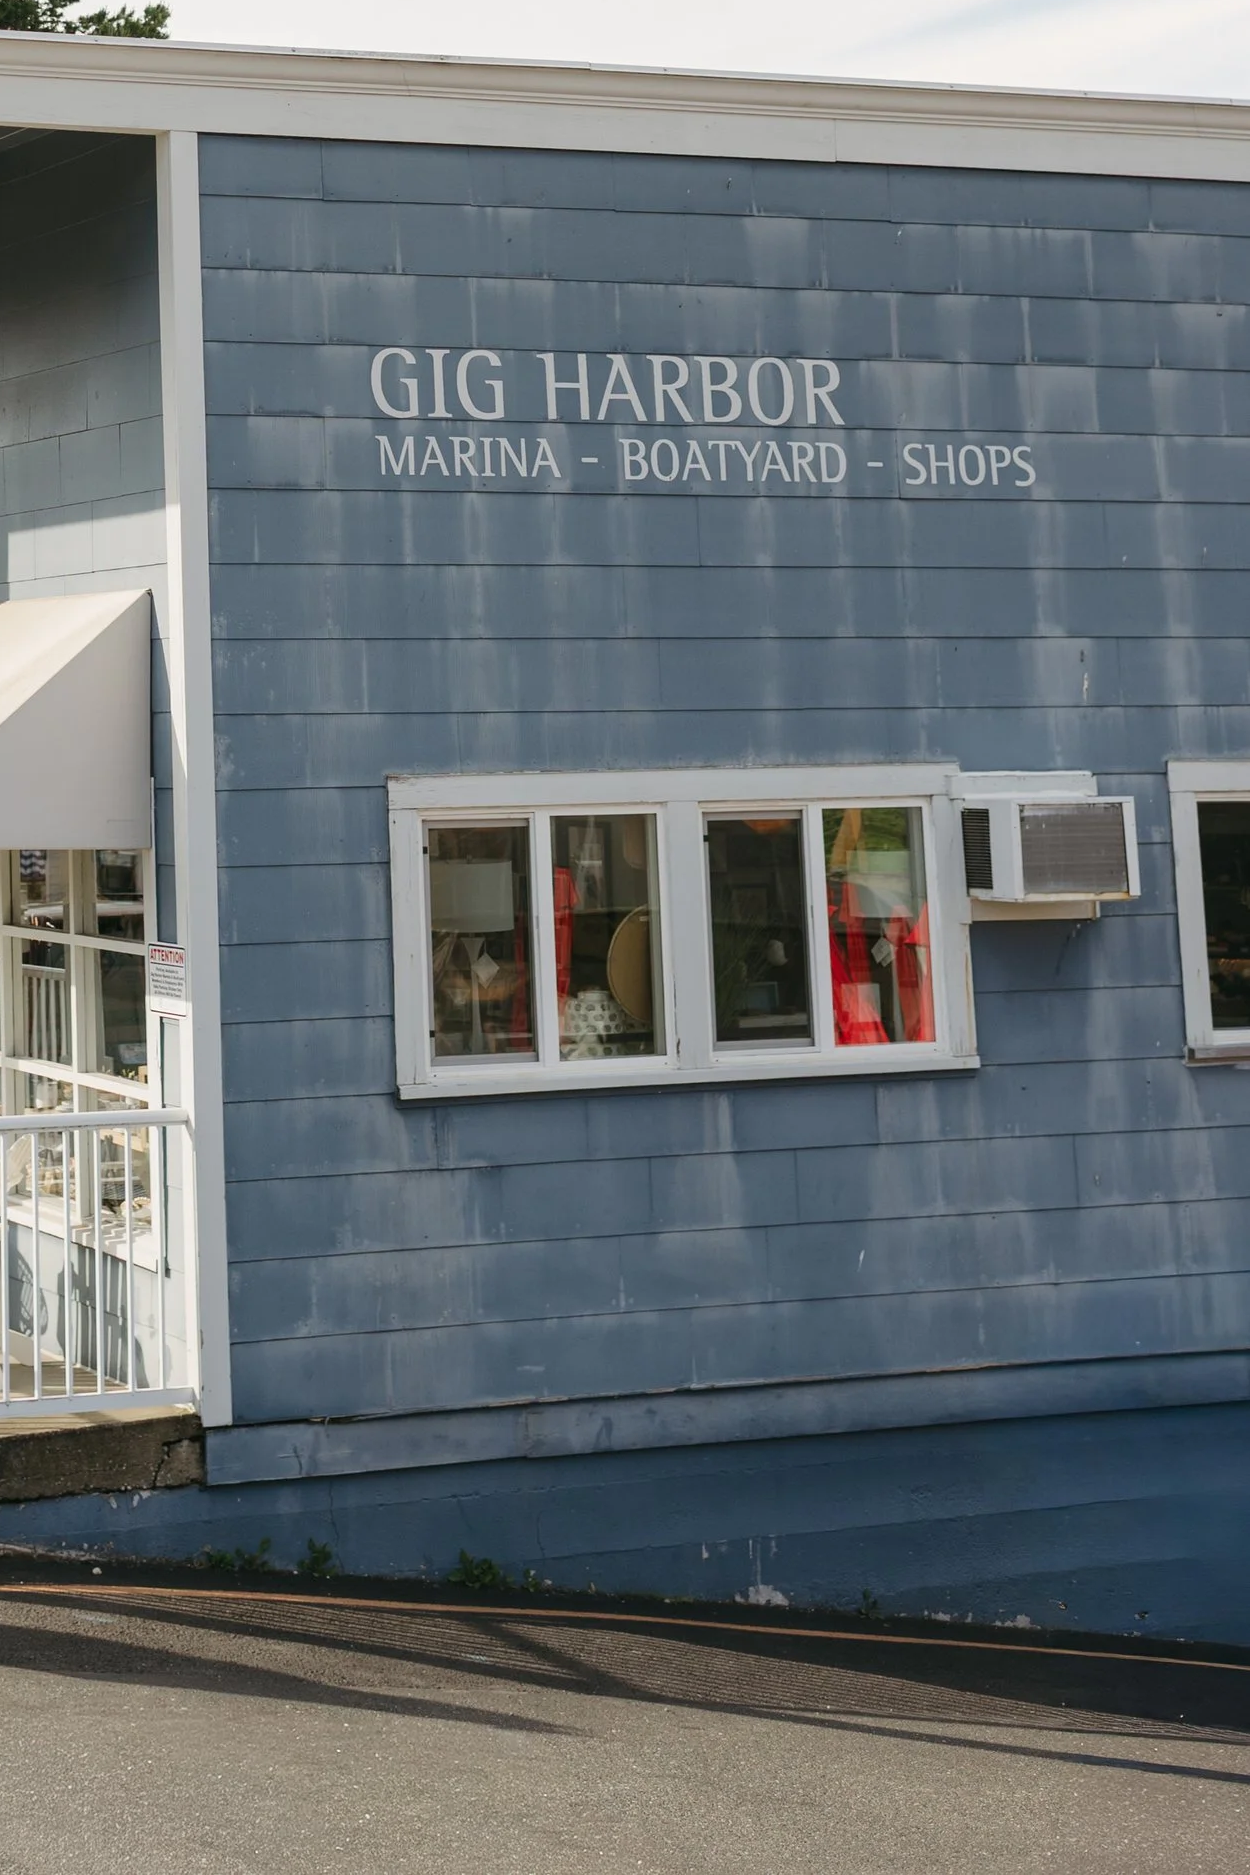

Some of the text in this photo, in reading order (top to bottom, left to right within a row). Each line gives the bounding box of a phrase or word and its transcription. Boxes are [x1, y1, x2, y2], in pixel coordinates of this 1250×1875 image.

[370, 347, 845, 426] GIG HARBOR
[375, 435, 562, 479] MARINA
[618, 438, 847, 484] BOATYARD
[903, 442, 1037, 488] SHOPS
[150, 948, 184, 965] ATTENTION
